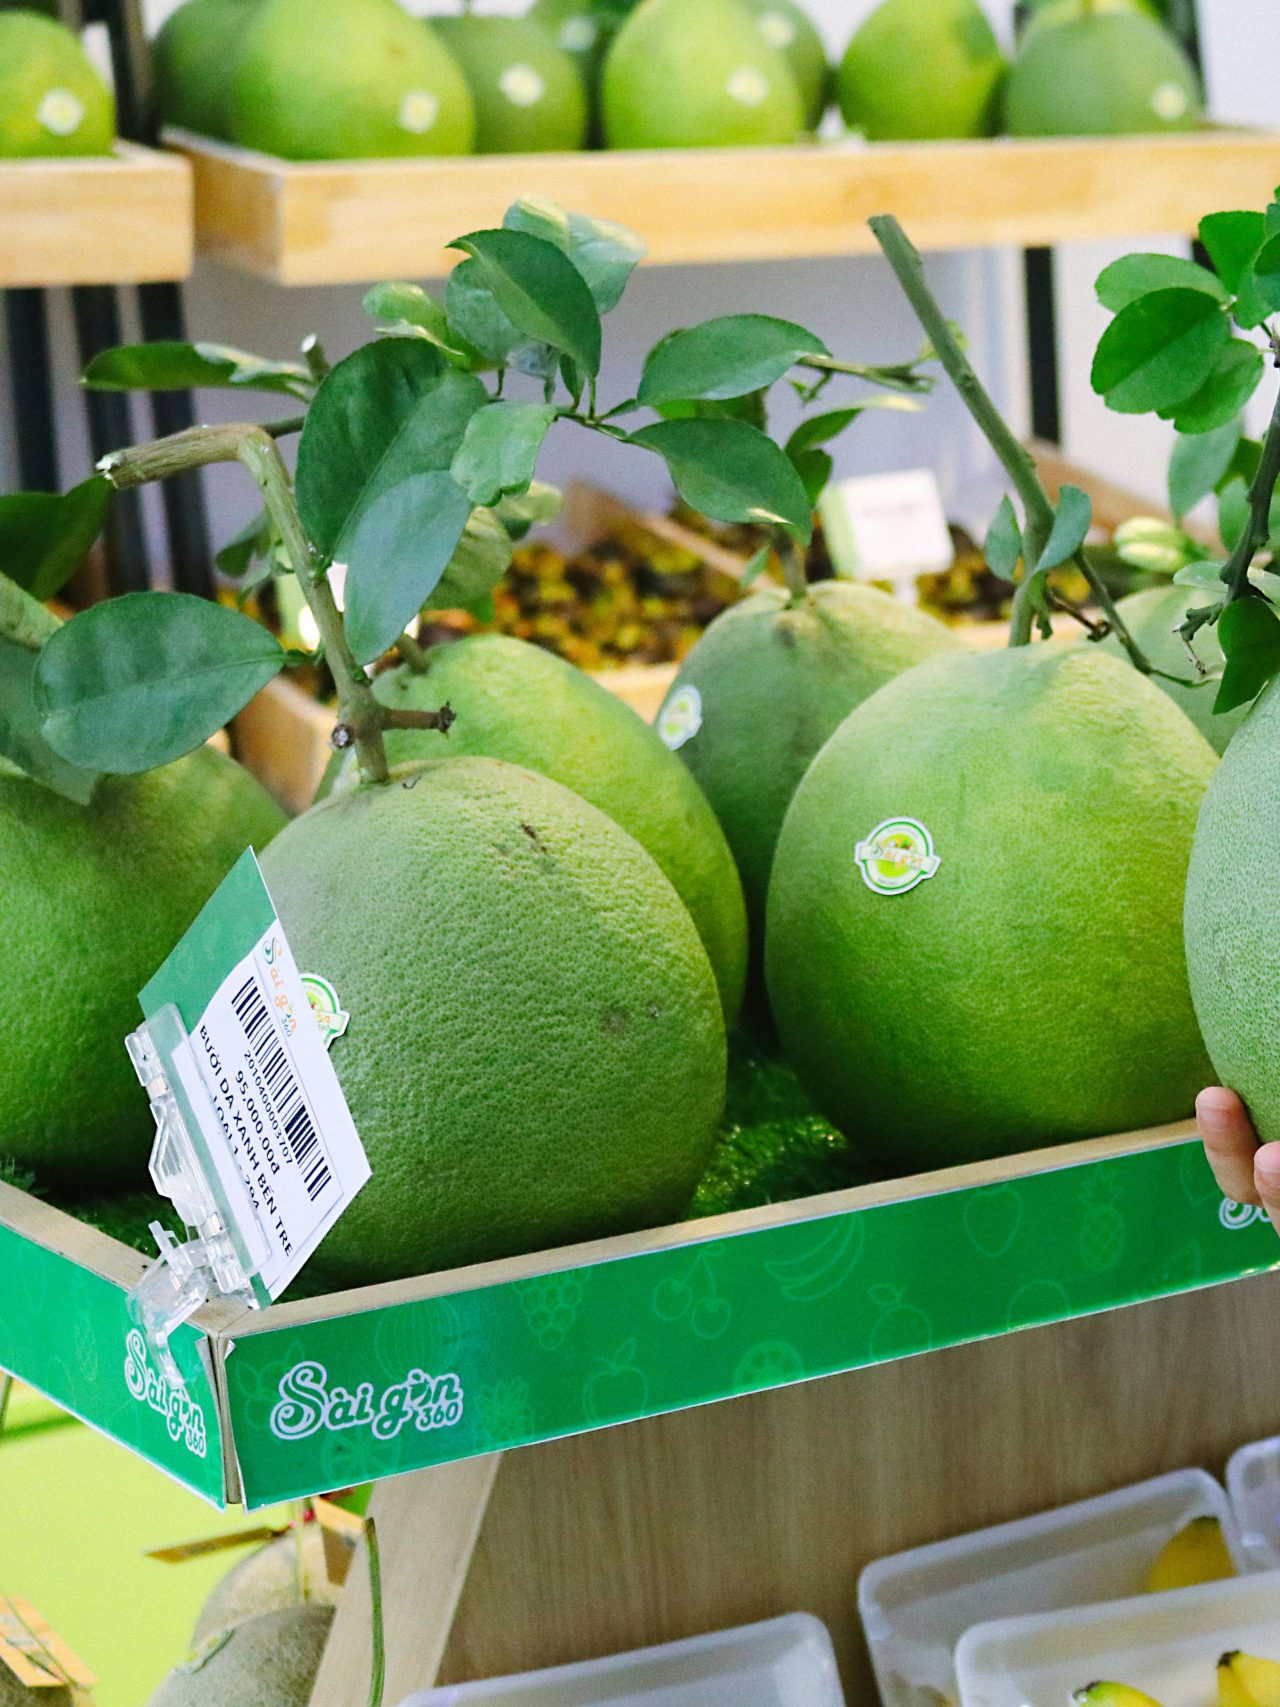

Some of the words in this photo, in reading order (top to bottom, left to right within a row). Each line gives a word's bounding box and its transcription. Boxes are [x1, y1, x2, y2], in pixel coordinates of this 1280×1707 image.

[244, 1049, 293, 1164] 2010400003707
[220, 1078, 234, 1110] DA
[233, 1109, 260, 1171] XANH
[275, 1216, 293, 1257] TRE
[415, 1403, 464, 1431] 360
